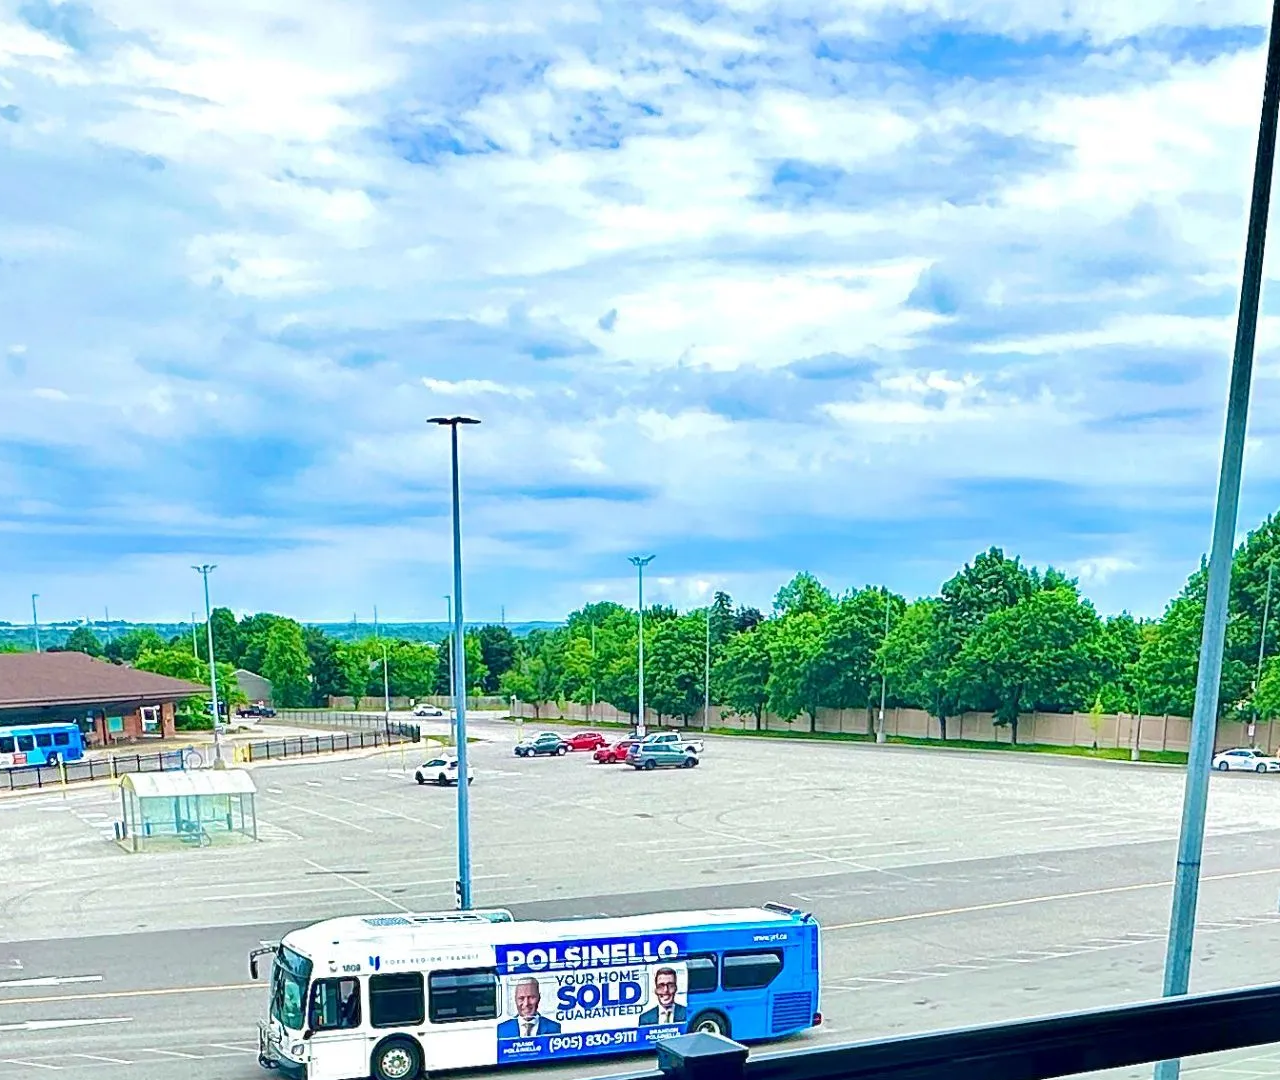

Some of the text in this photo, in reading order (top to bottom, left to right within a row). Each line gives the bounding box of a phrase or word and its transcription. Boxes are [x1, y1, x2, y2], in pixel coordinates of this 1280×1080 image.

[410, 956, 442, 964] REGON
[445, 953, 479, 961] TANST
[506, 940, 679, 972] POLSINELLO
[555, 969, 640, 986] YOUR HOME
[556, 981, 642, 1011] SOLD
[555, 1004, 644, 1021] GUARANTEED
[549, 1030, 638, 1053] (905) 830-9111
